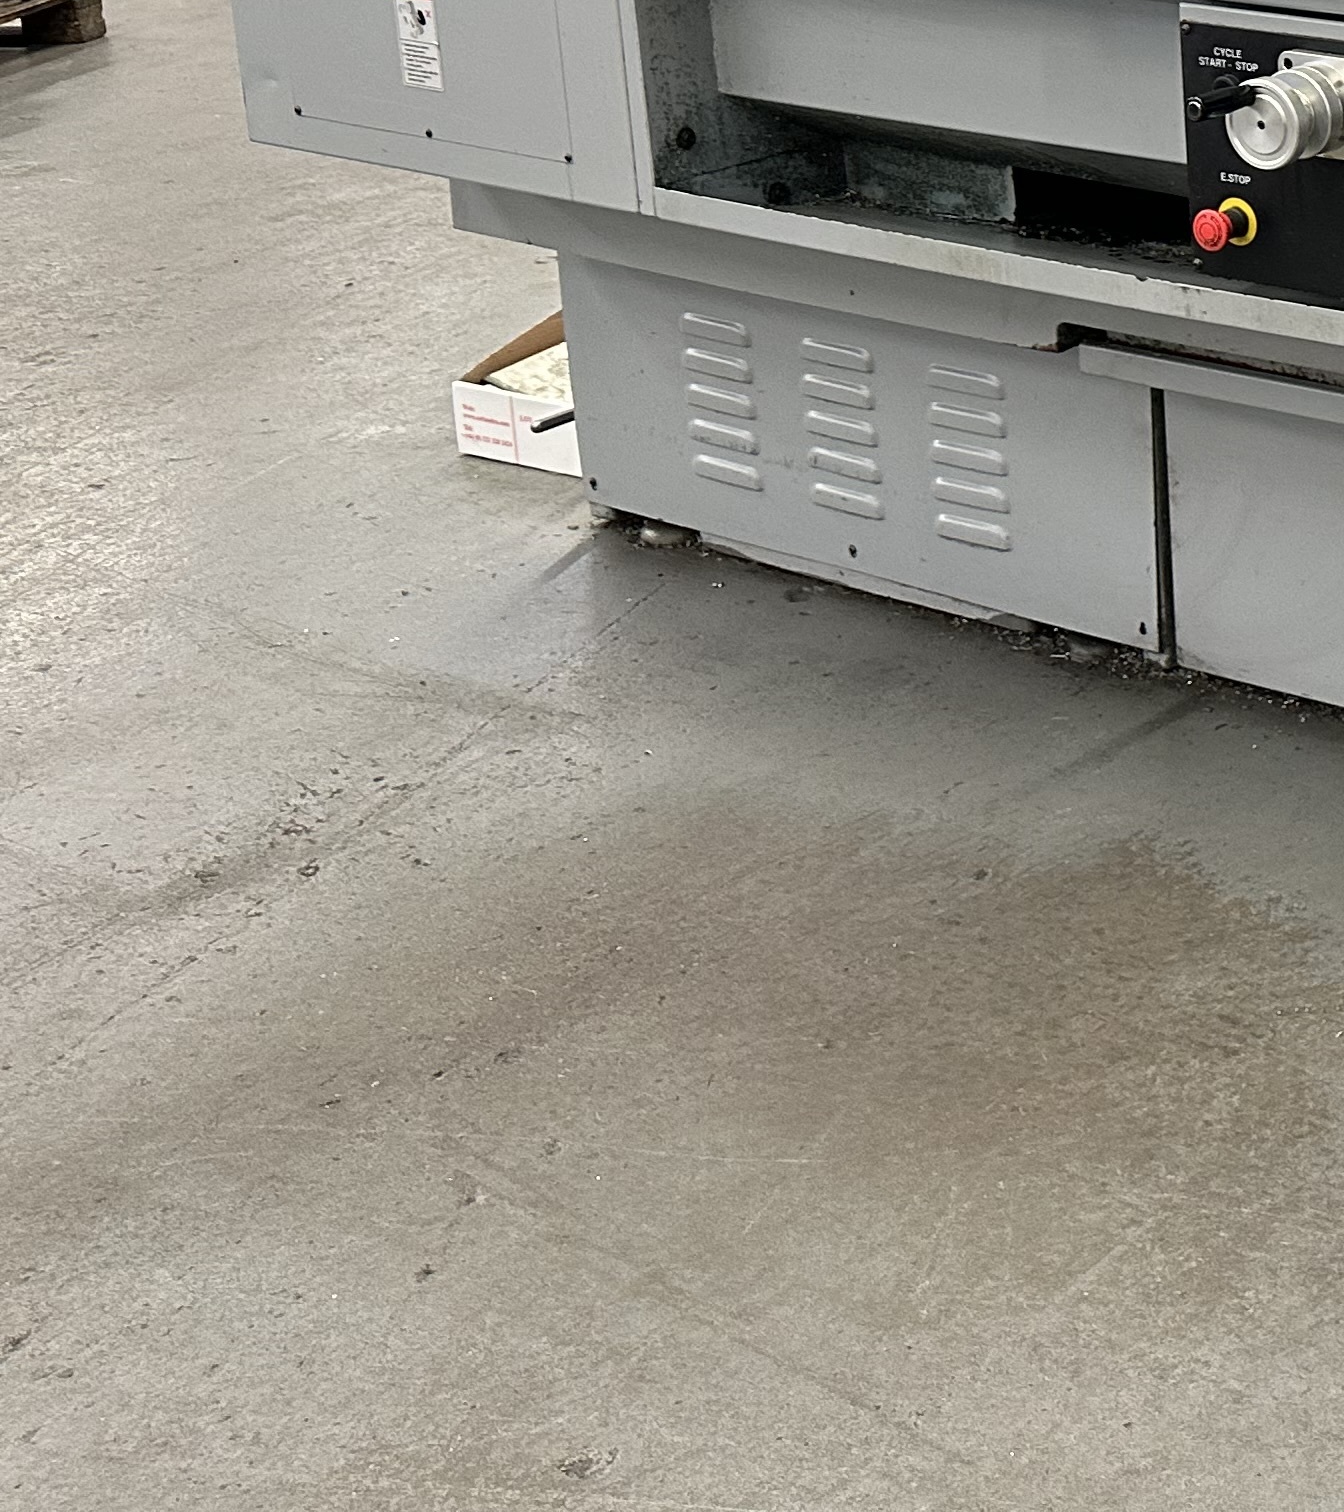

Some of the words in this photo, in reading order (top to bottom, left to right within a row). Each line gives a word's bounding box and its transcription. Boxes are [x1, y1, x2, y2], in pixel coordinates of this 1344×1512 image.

[1213, 46, 1243, 59] CYCLE
[1198, 56, 1227, 68] START
[1235, 60, 1259, 72] STOP
